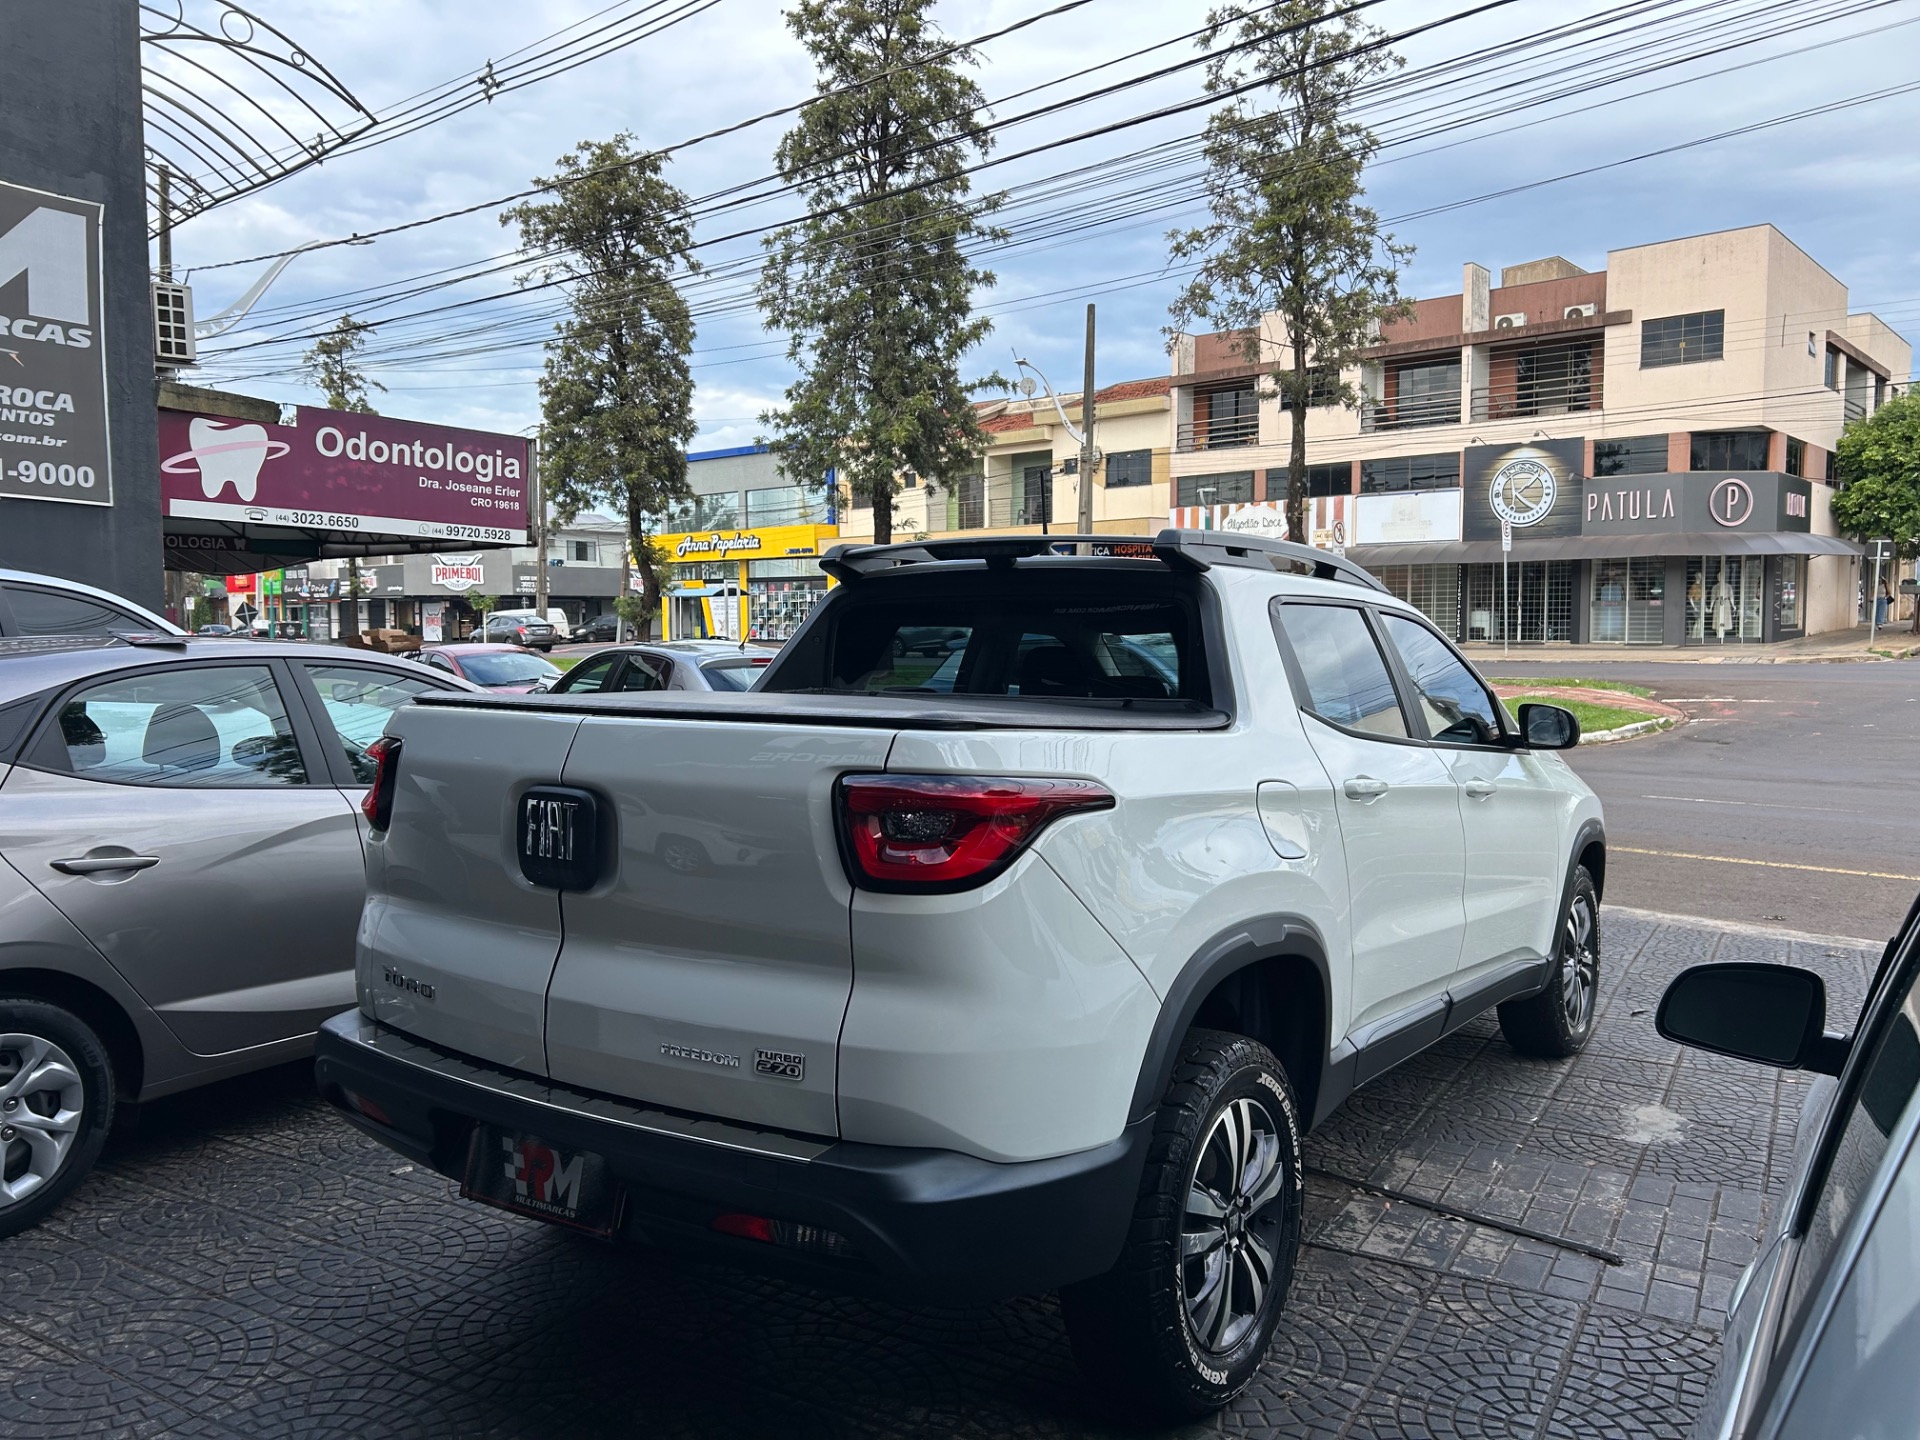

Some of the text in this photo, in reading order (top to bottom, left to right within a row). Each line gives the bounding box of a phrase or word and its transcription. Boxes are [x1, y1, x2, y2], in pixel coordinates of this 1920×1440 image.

[0, 408, 55, 426] NTOS
[0, 433, 67, 447] om.br
[315, 426, 520, 482] Odontologia
[418, 476, 520, 498] Dra. Joseane Erler
[470, 497, 520, 511] CRO 19618
[1587, 488, 1675, 522] PATULA
[275, 512, 359, 528] (44) 3023.6650
[1227, 516, 1283, 531] Algodão Doce
[431, 525, 511, 542] (44) 99720.5928
[676, 532, 761, 557] Anna Papelaria
[1092, 544, 1153, 556] ICA HOSPITA
[435, 567, 481, 582] PRIMEBOI
[526, 797, 579, 862] FIAT
[381, 962, 435, 1000] TORO
[659, 1042, 740, 1067] FREEDOM
[756, 1049, 802, 1065] TURBO
[756, 1060, 801, 1078] 270
[1256, 1070, 1287, 1101] XBRI
[1281, 1097, 1299, 1157] Brutus
[514, 1194, 576, 1219] MULTIMARCAS
[1197, 1361, 1229, 1385] XBRI
